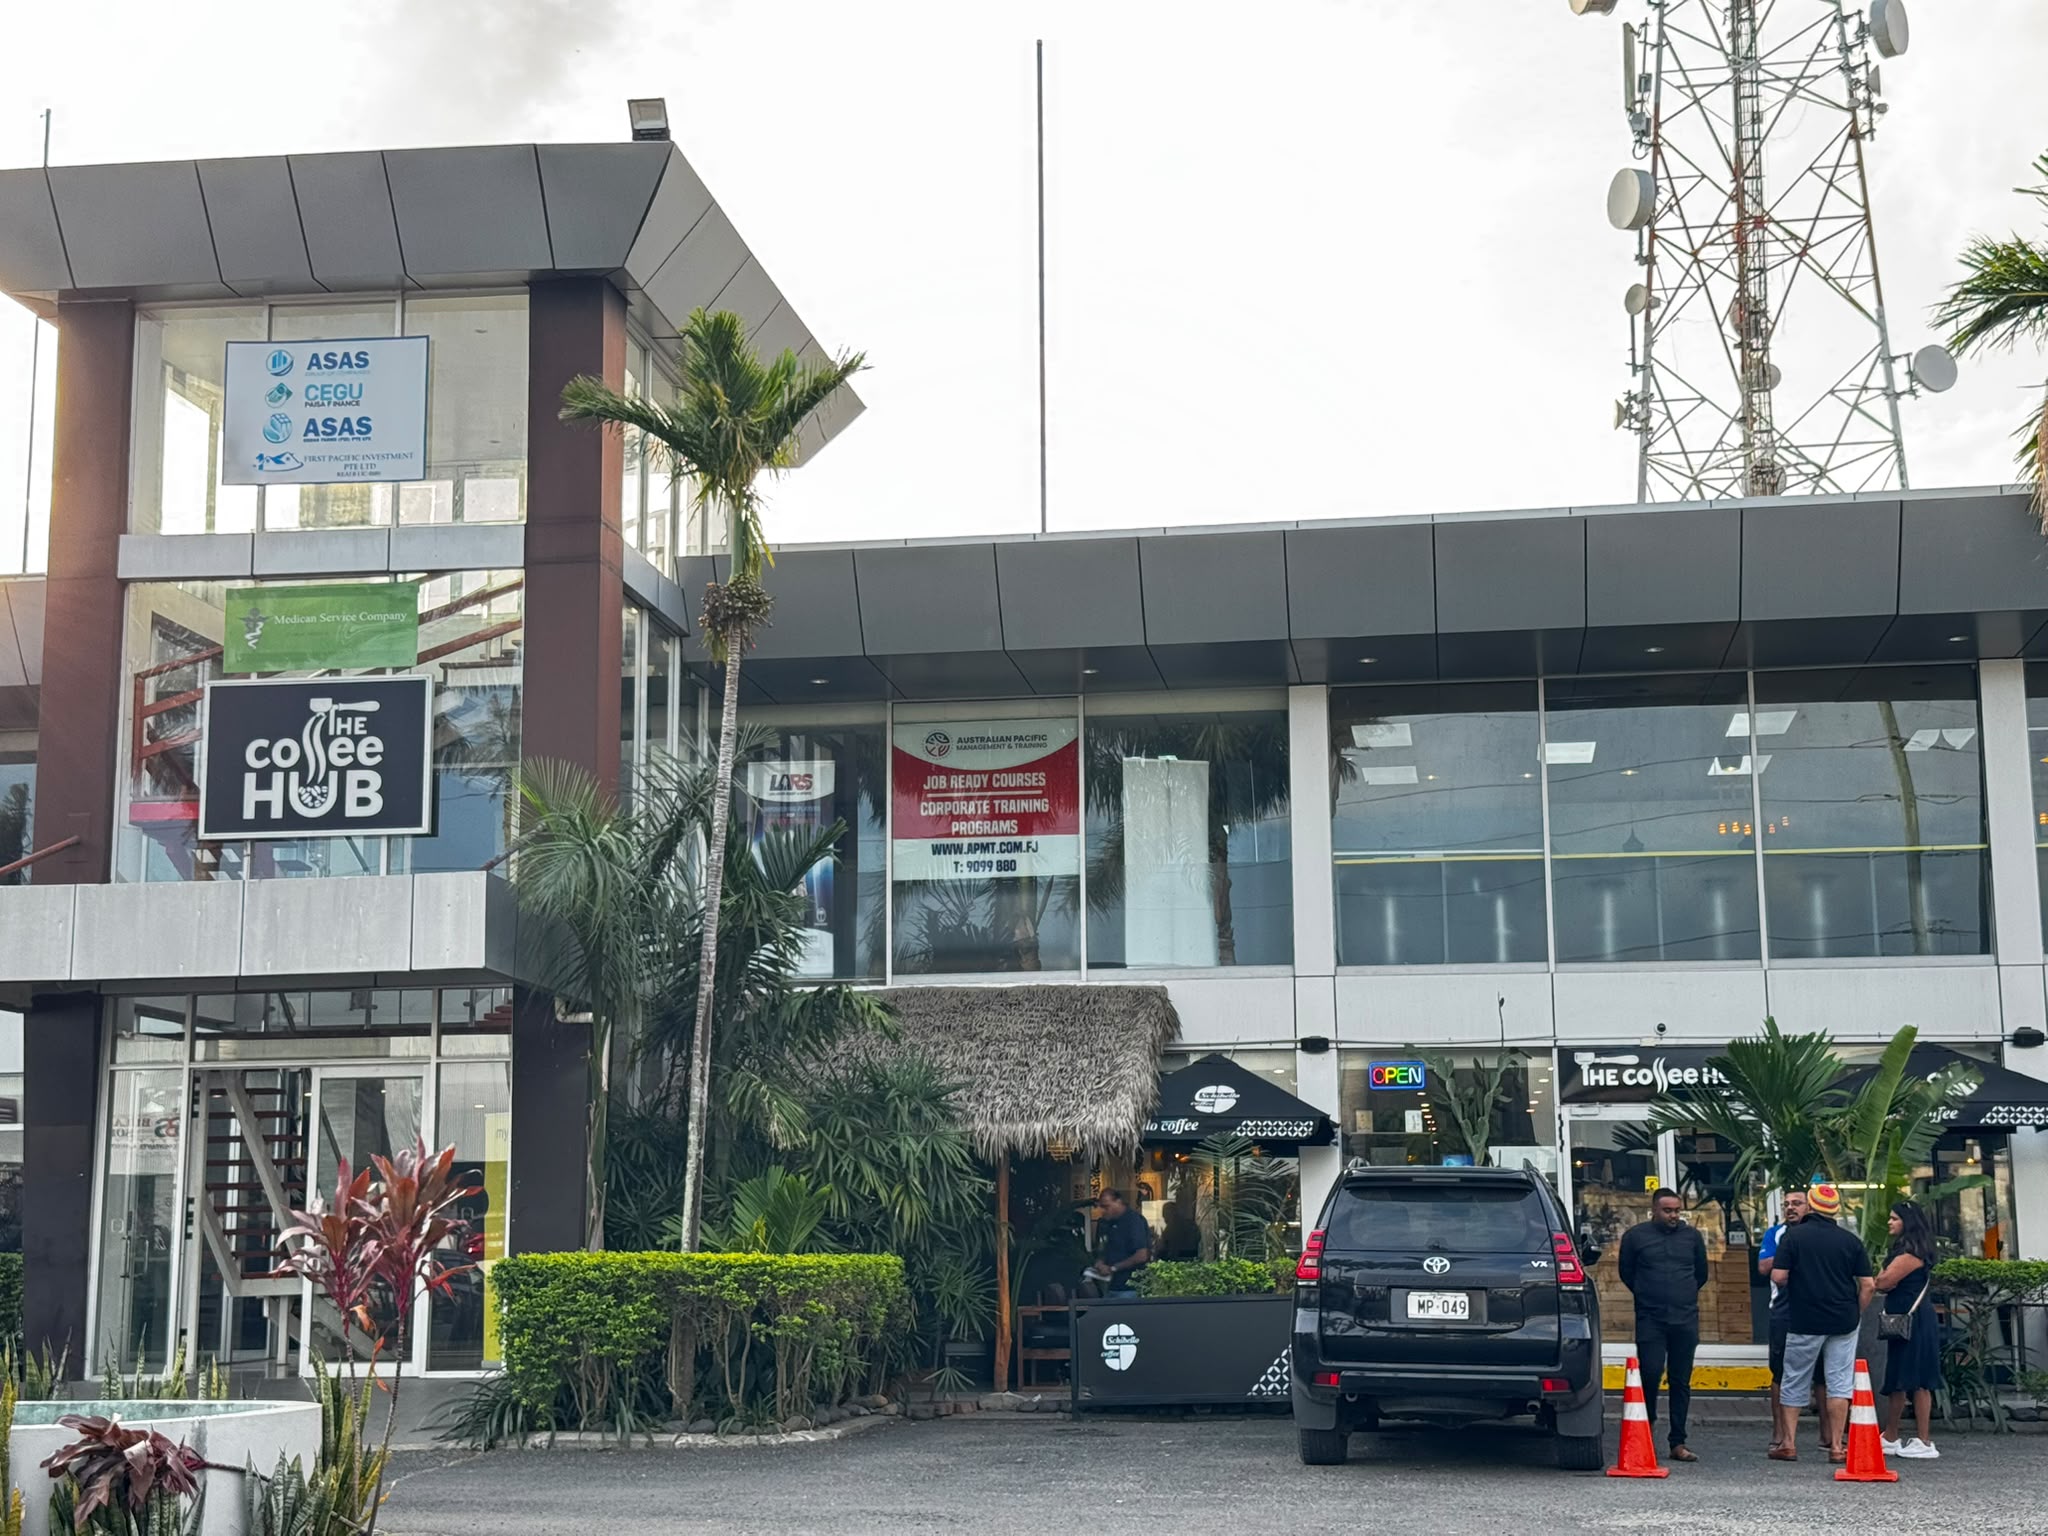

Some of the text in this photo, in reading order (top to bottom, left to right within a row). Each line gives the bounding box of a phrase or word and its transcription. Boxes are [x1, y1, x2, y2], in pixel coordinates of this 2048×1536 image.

[306, 351, 370, 370] ASAS
[305, 383, 363, 401] CEGU
[303, 416, 373, 437] ASAS
[362, 452, 414, 461] INVESTMENT
[274, 612, 407, 624] Medican Service Company
[956, 743, 1006, 751] MANAGEMENT
[1015, 742, 1048, 750] TRAINING
[957, 734, 1048, 744] AUSTRALIAN PACIFIC
[923, 772, 1046, 790] JOB READY COURSES
[243, 770, 383, 819] HUB
[920, 798, 1049, 816] CORPORATE TRAINING
[951, 820, 1018, 836] PROGRAMS
[931, 841, 1039, 856] WWW.APMT.COM.FJ
[953, 859, 1017, 873] T: 9099 880
[1371, 1067, 1422, 1084] OPEN
[1581, 1063, 1619, 1086] THE
[1160, 1118, 1200, 1135] coffee
[1531, 1260, 1549, 1268] VX
